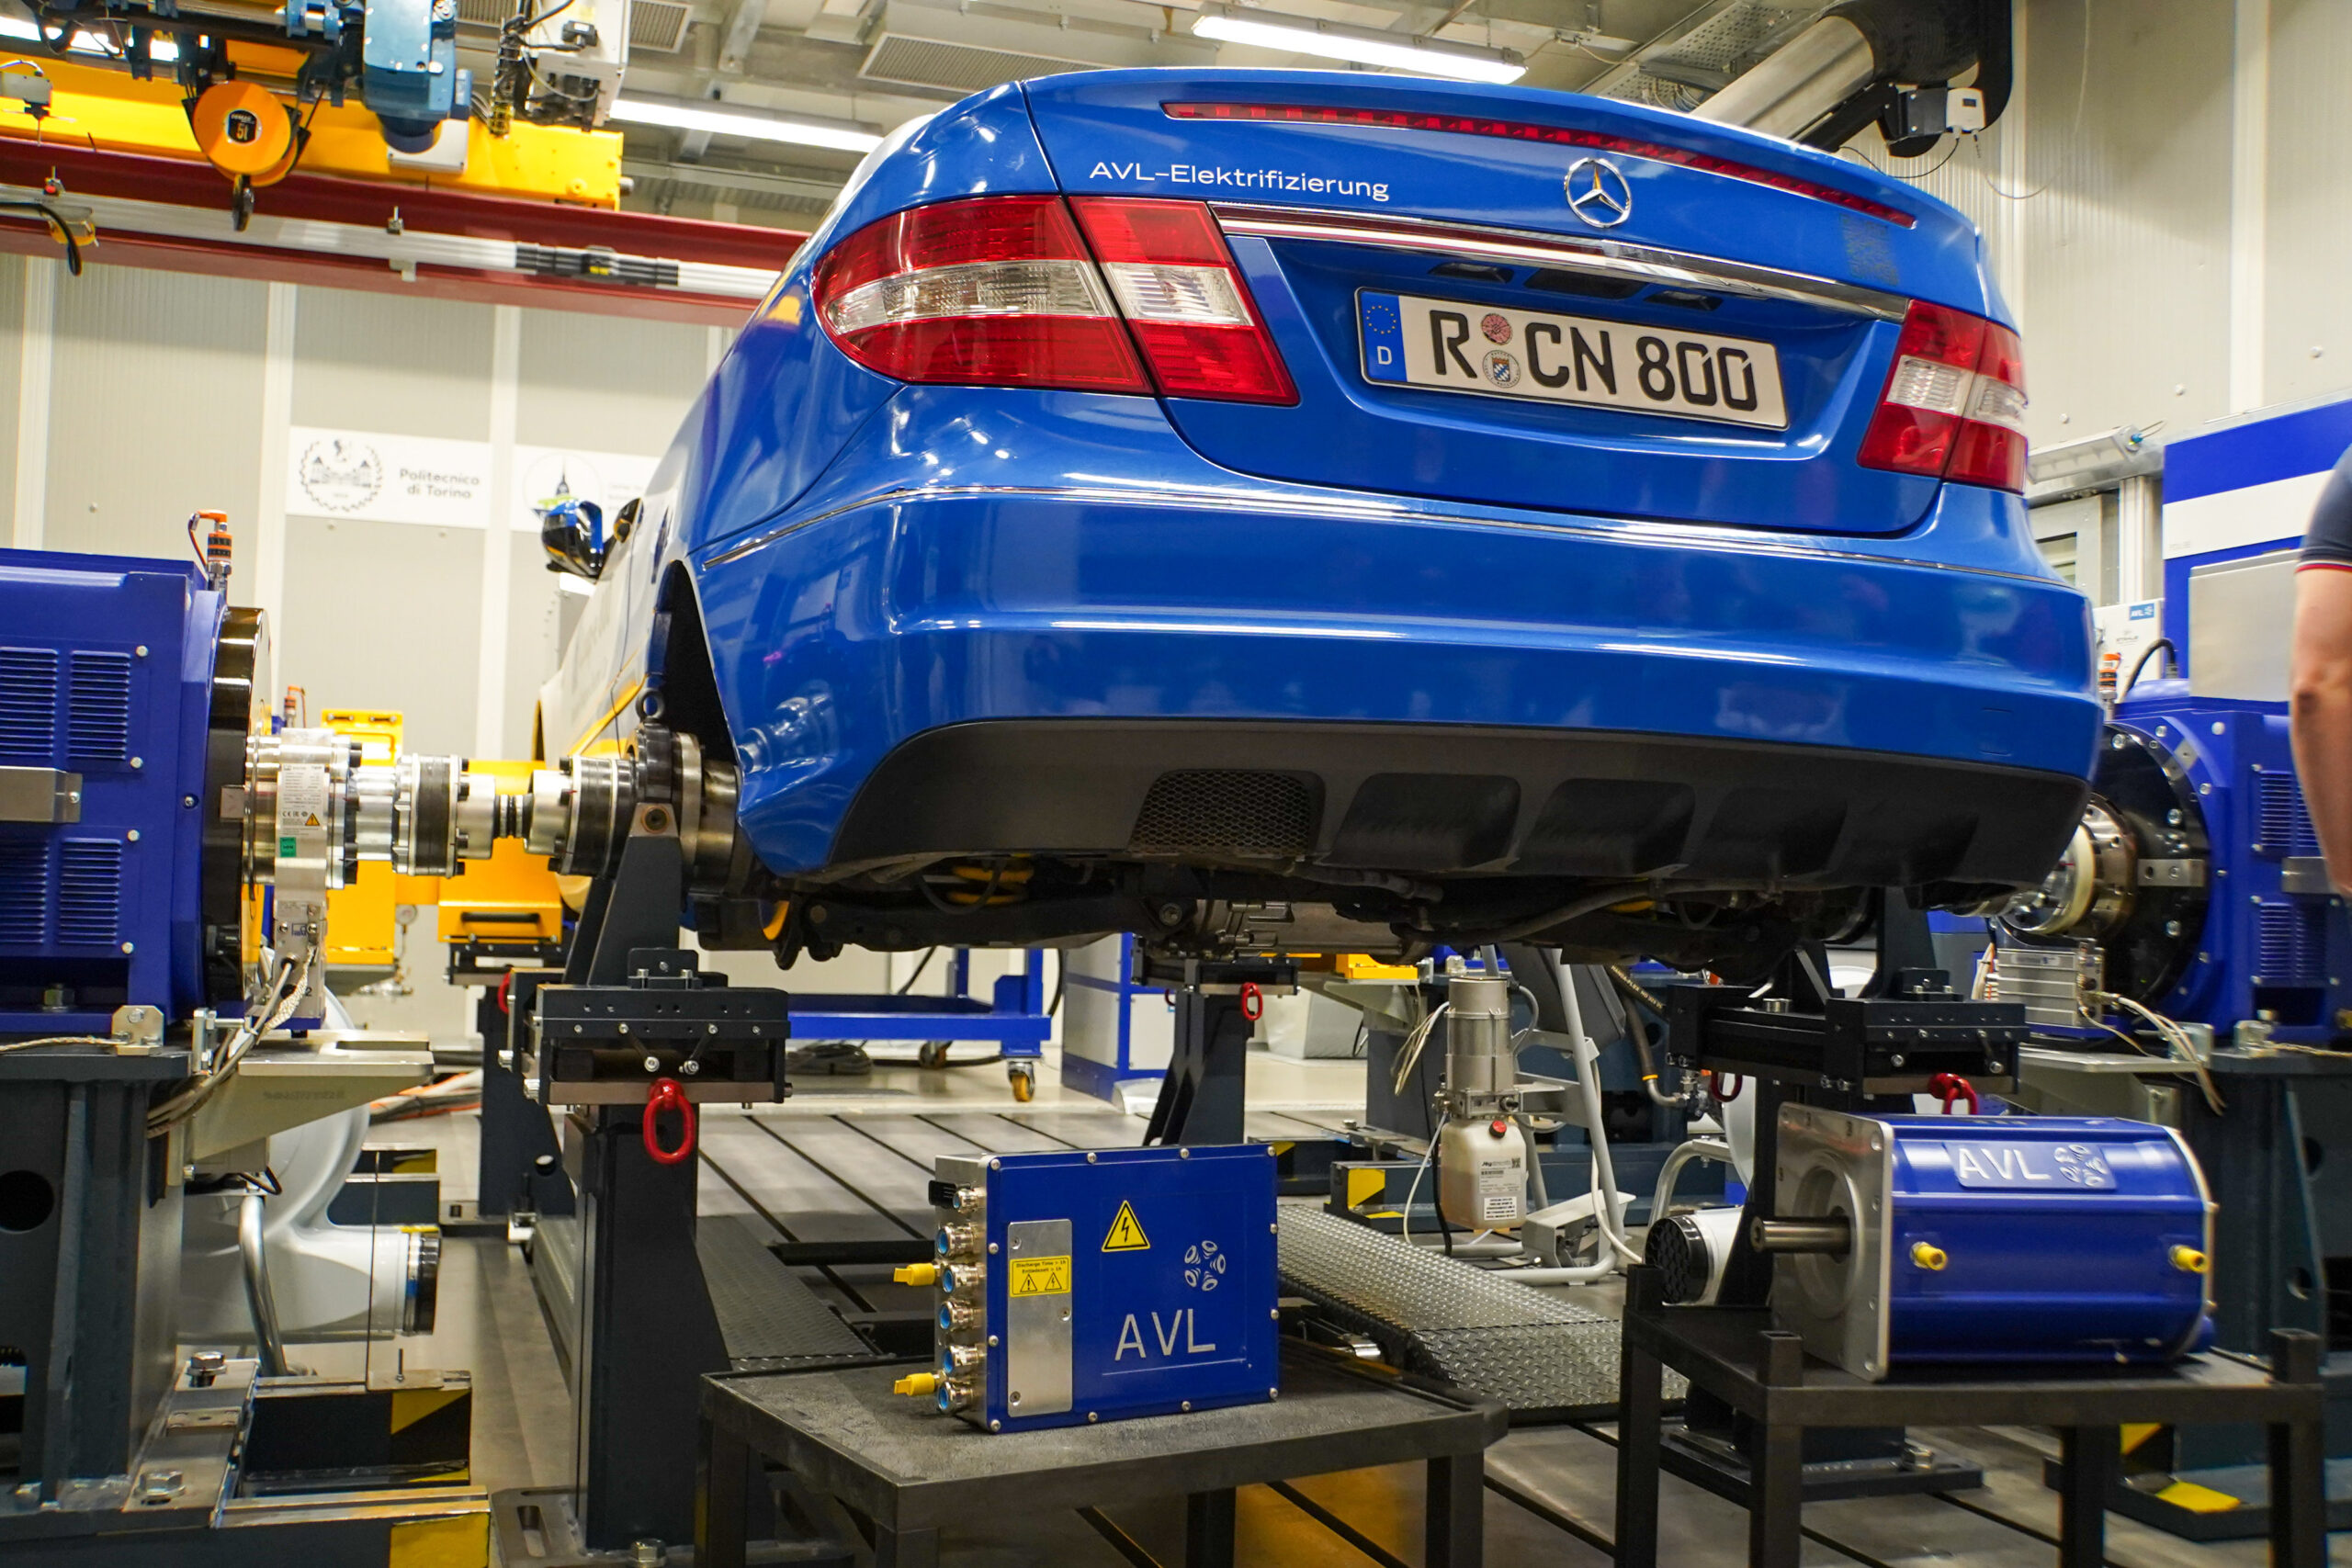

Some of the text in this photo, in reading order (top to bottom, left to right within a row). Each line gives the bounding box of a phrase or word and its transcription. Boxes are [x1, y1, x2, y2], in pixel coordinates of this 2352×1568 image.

[1089, 162, 1390, 201] AVL-Elektrifizierung
[1377, 346, 1393, 366] D
[1430, 310, 1477, 379] R
[1524, 321, 1618, 395] CN
[1635, 335, 1758, 412] 800
[399, 468, 481, 486] Politecnico
[407, 484, 472, 499] di Torino
[1958, 1146, 2052, 1180] AVL
[1114, 1308, 1216, 1361] AVL
